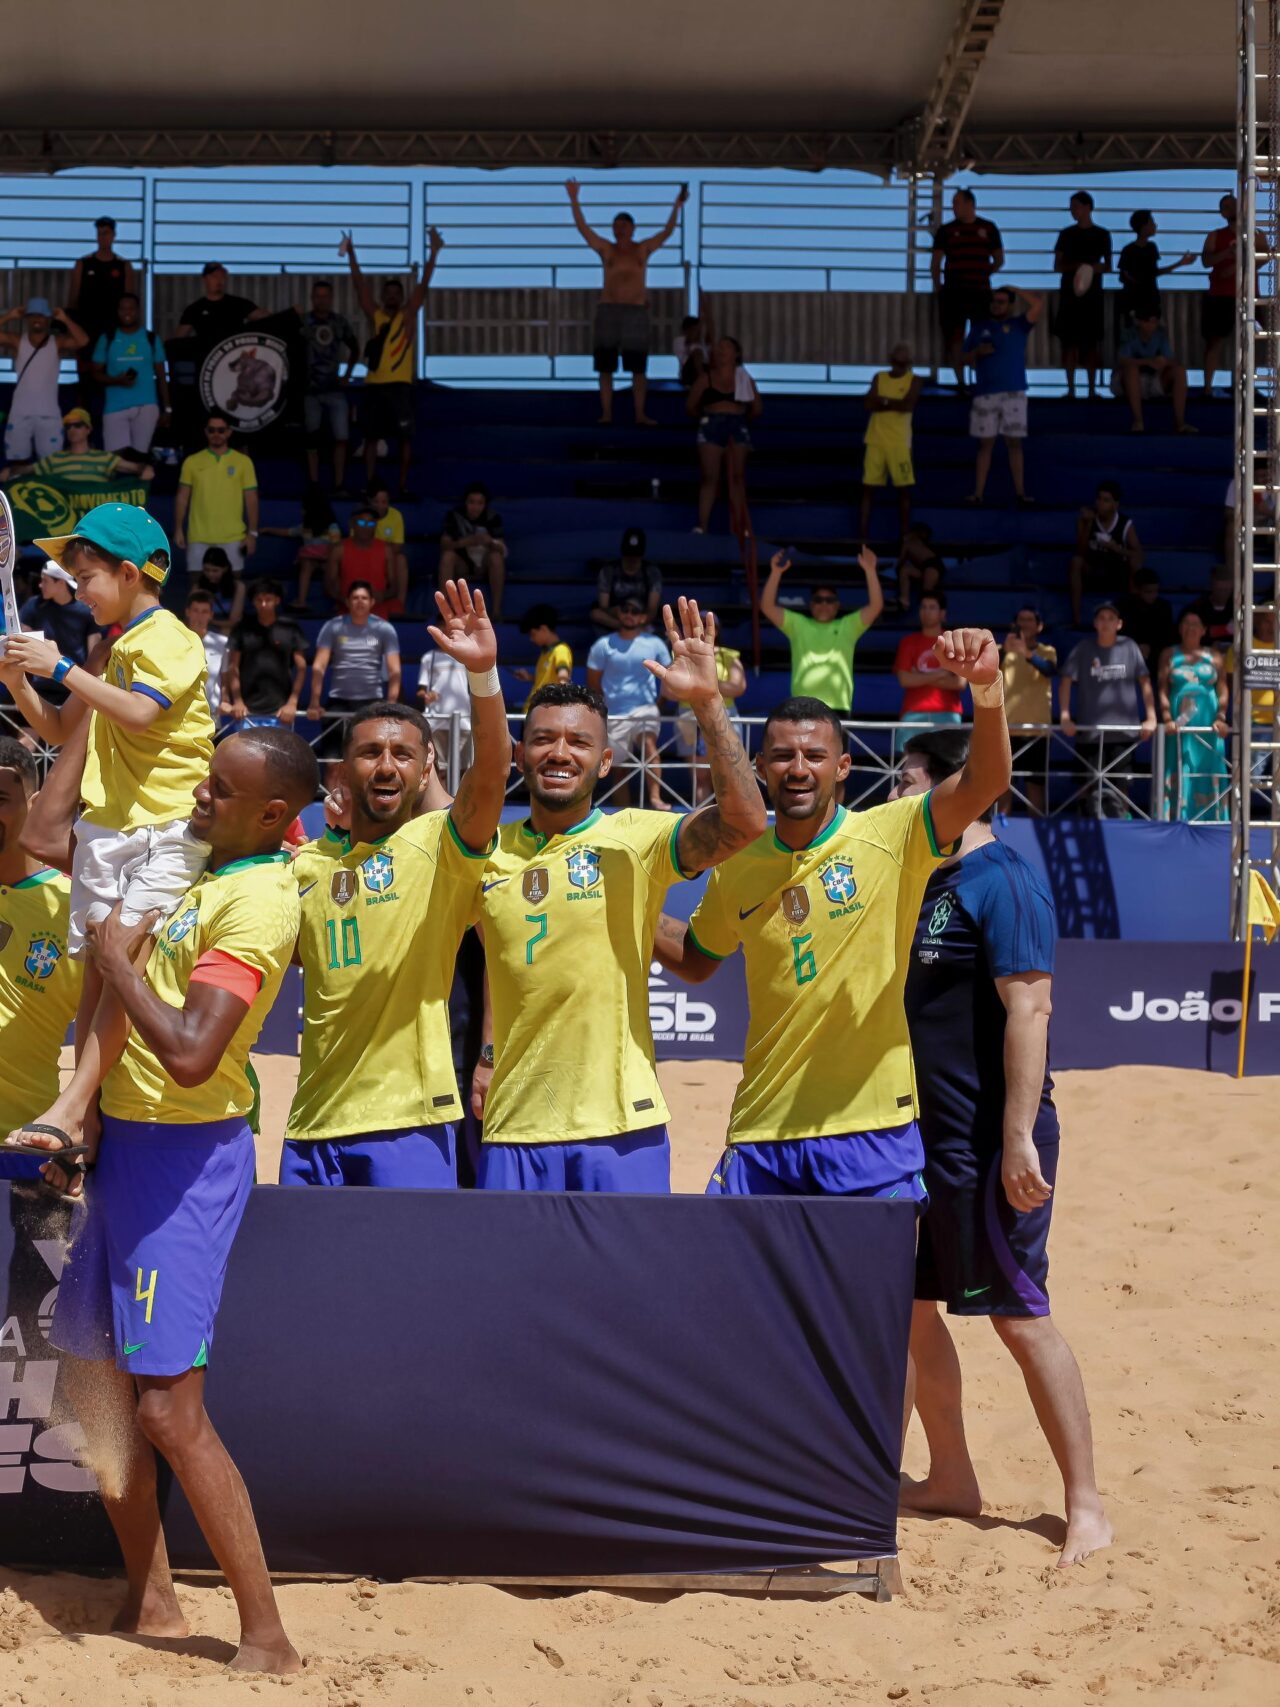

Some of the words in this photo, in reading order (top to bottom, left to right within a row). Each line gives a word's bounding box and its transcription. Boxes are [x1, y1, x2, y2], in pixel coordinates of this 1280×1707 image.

[372, 867, 385, 875] CBF
[832, 878, 845, 887] CBF
[365, 892, 400, 906] BRASIL
[566, 890, 603, 901] BRASIL
[828, 902, 865, 920] BRASIL
[326, 916, 362, 970] 10
[524, 913, 548, 965] 7
[790, 932, 818, 986] 6
[14, 975, 46, 994] BRASIL
[1108, 990, 1244, 1022] João
[135, 1266, 160, 1326] 4
